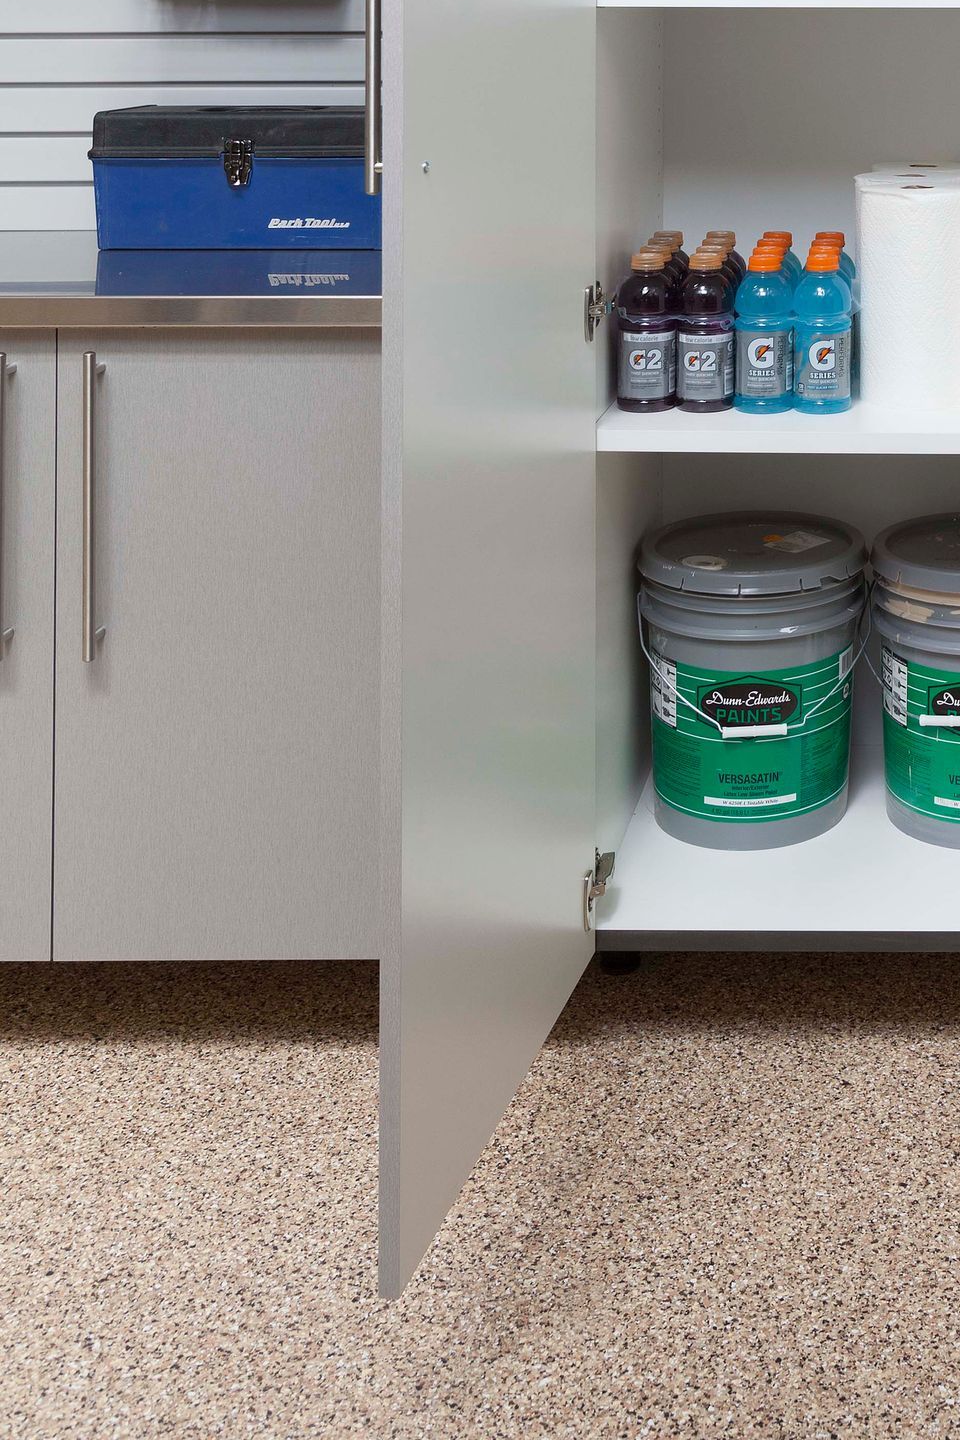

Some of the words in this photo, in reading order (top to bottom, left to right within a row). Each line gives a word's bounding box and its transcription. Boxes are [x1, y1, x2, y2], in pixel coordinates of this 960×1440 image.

[267, 218, 304, 229] Park
[304, 217, 337, 229] Tool
[629, 348, 662, 371] G2
[683, 350, 717, 372] G2
[747, 337, 774, 369] G
[808, 339, 835, 371] G
[748, 369, 775, 377] SERIES
[706, 690, 792, 707] Dunn-Edwards
[716, 707, 782, 723] PAINTS
[718, 771, 780, 785] VERSASATIN
